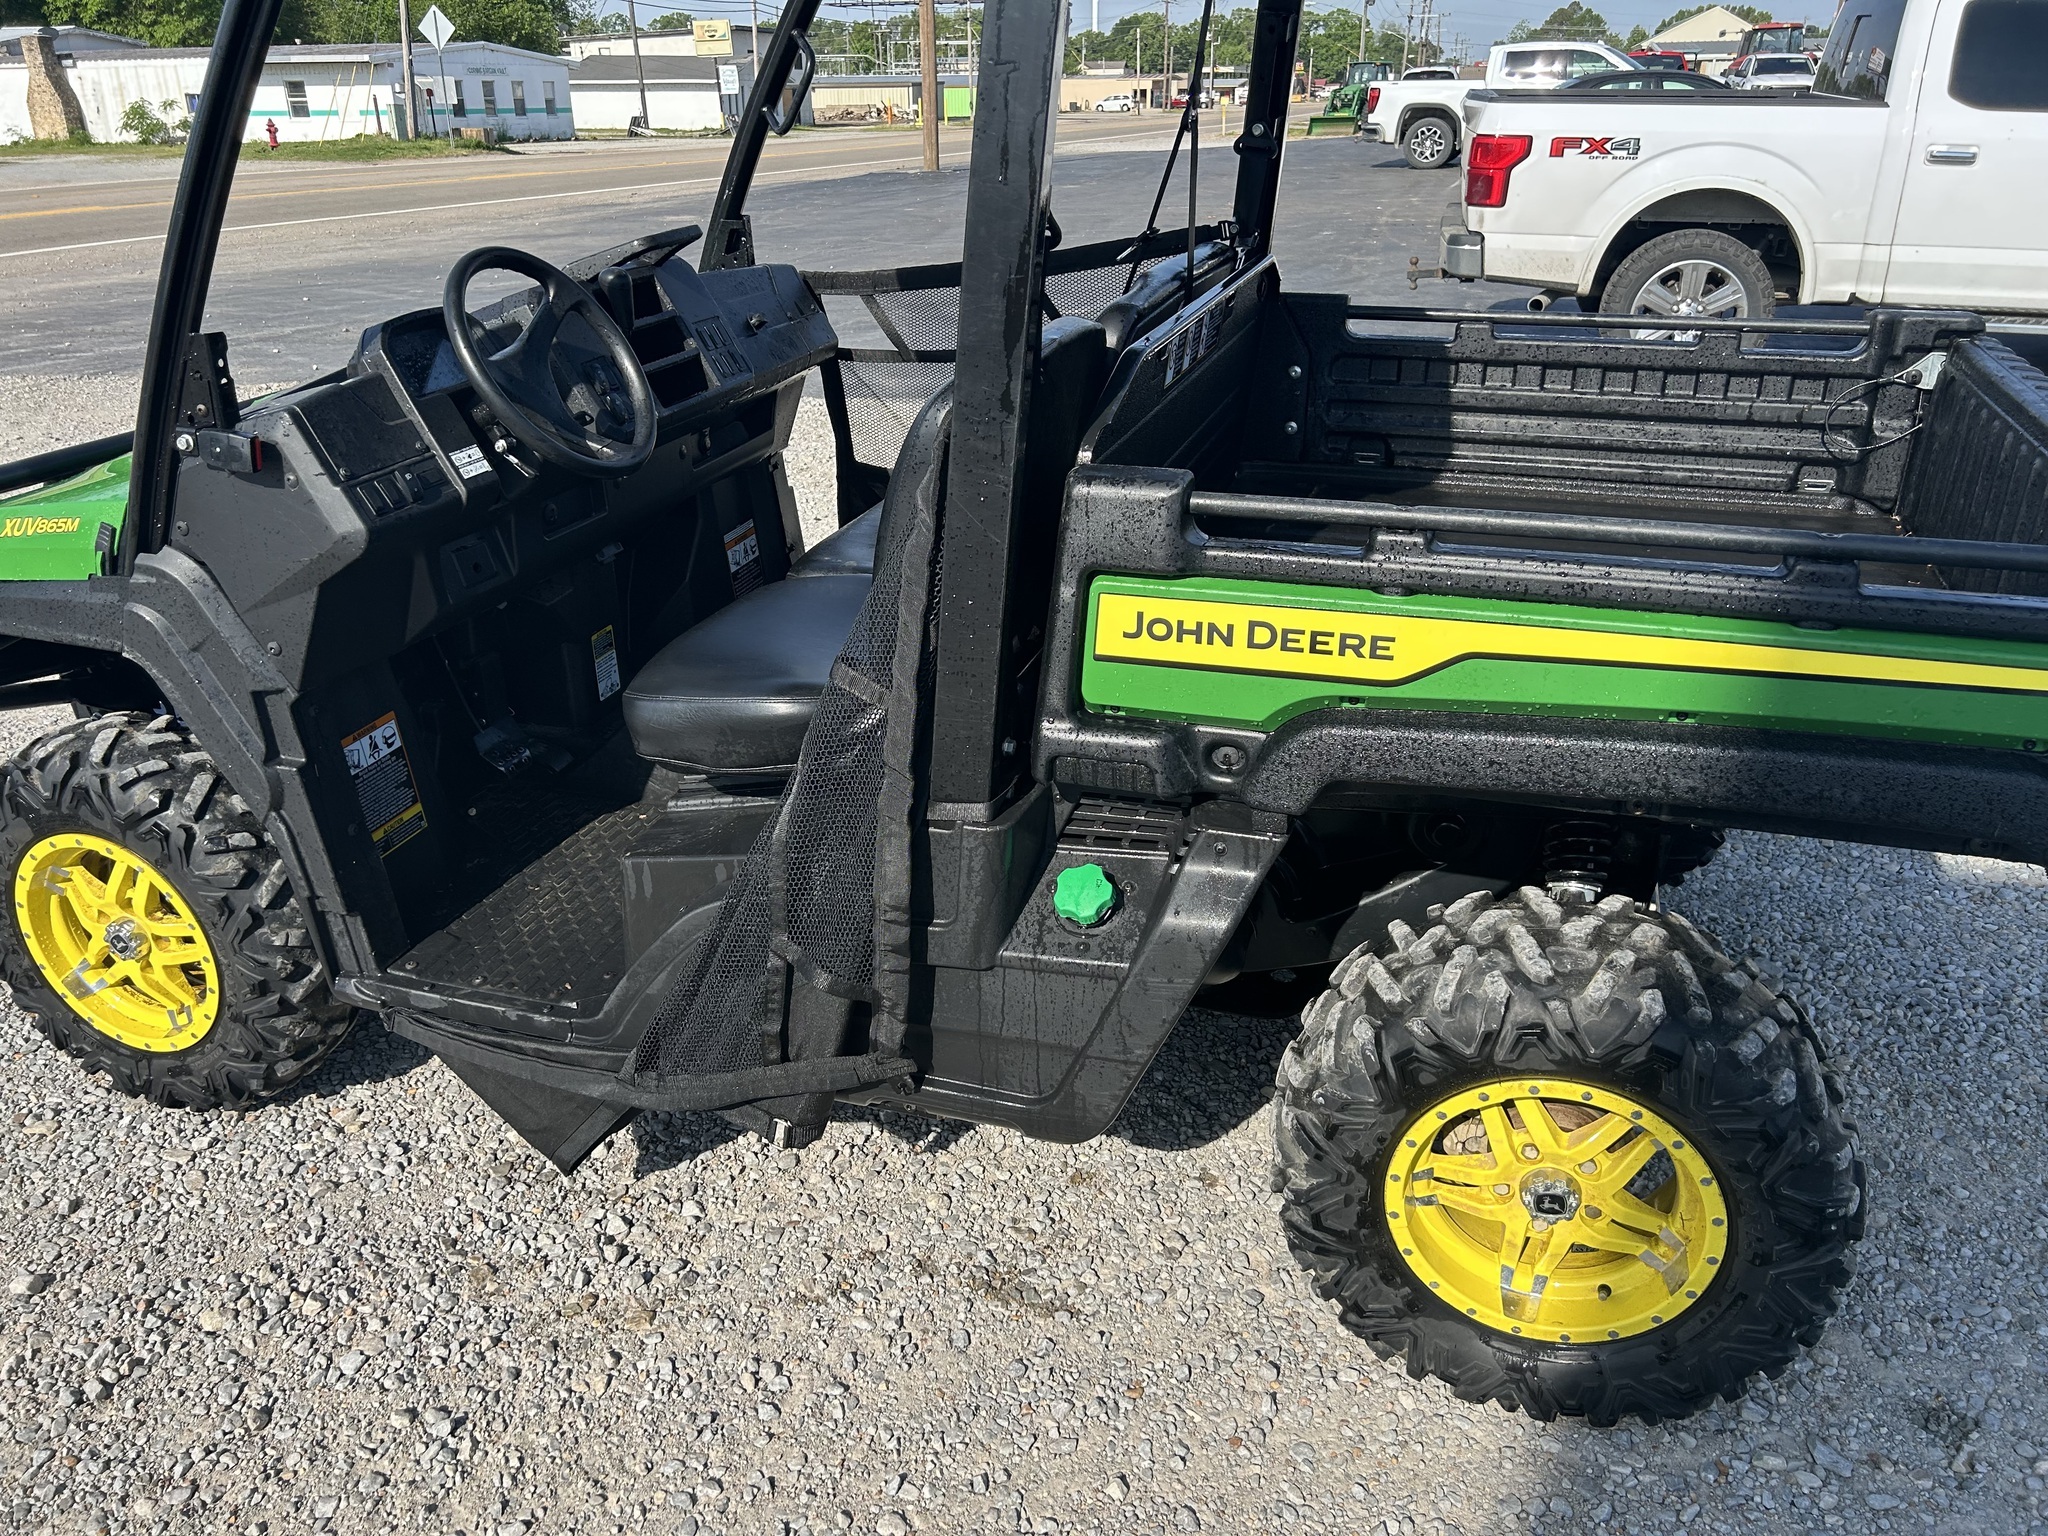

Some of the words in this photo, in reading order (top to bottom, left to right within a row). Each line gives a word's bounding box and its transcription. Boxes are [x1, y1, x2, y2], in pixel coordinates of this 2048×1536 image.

[1549, 136, 1640, 158] FX4
[0, 516, 80, 538] XUV865M
[1122, 611, 1234, 647] JOHN
[1247, 620, 1396, 661] DEERE
[386, 817, 405, 831] CAUTION
